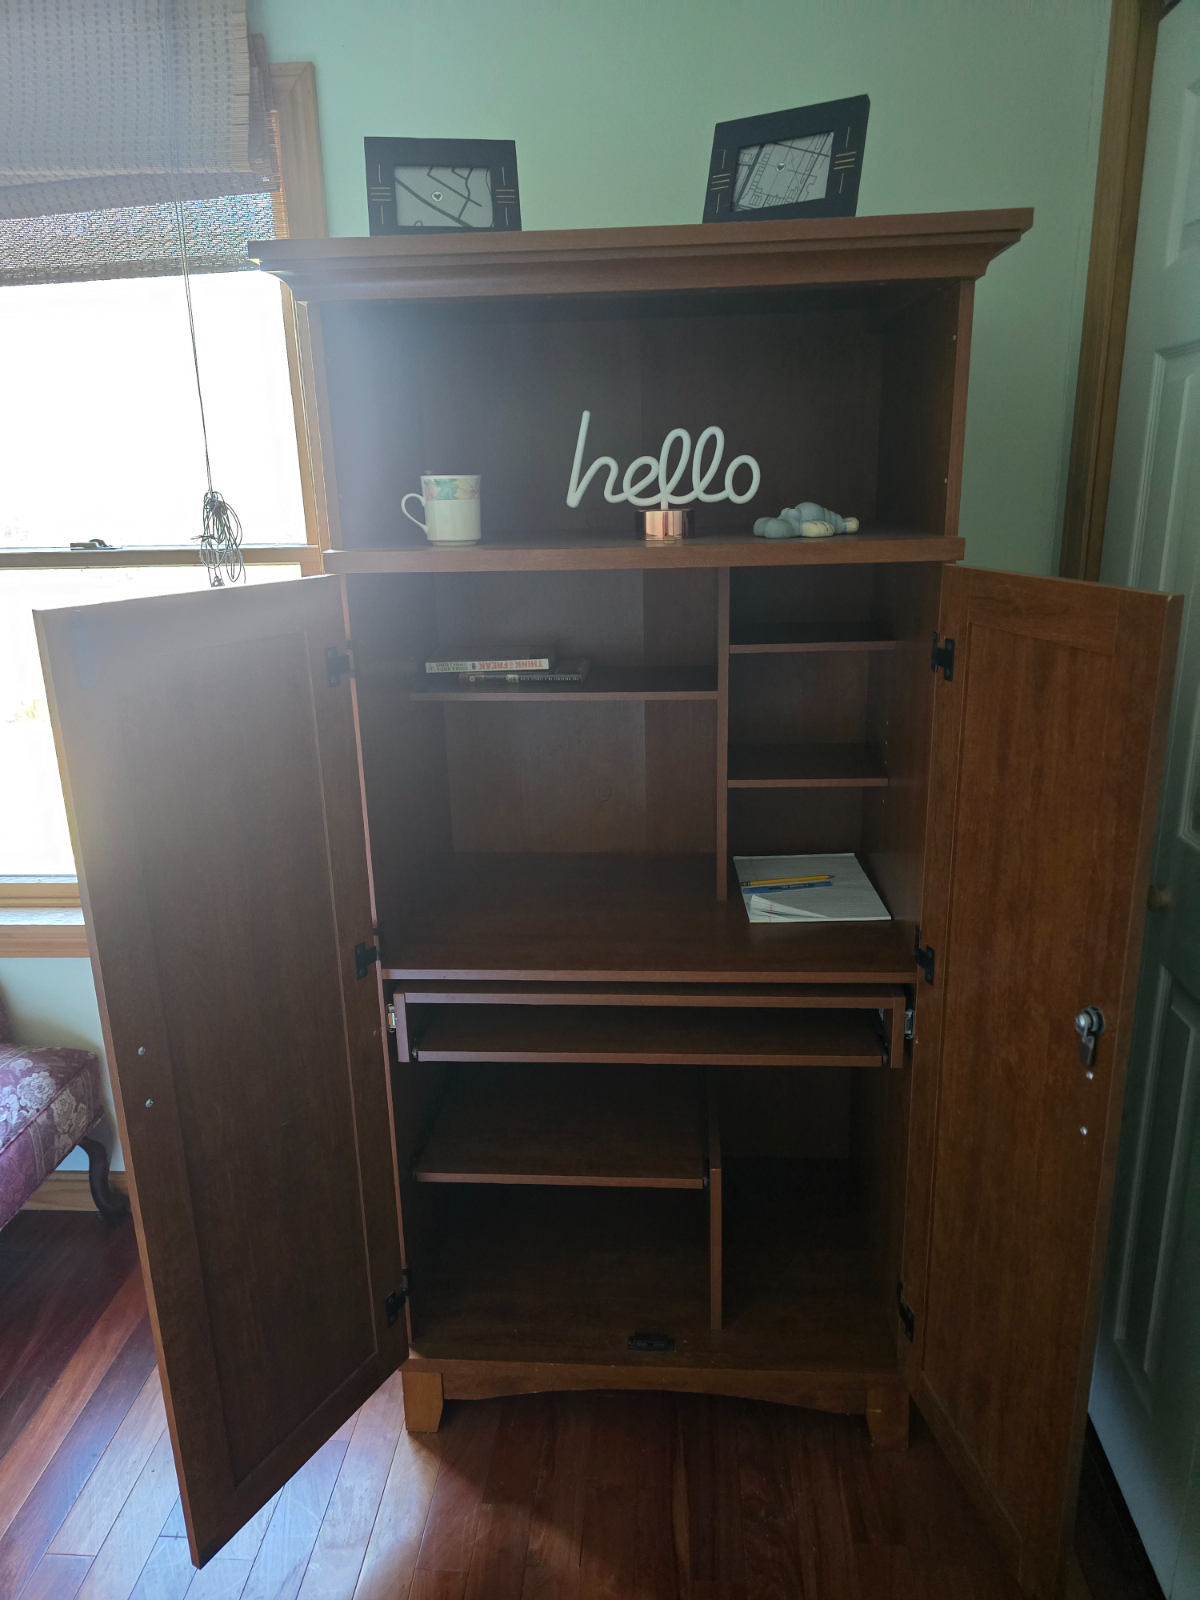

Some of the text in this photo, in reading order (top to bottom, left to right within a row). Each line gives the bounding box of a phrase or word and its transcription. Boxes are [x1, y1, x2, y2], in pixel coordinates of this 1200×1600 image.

[566, 410, 761, 508] hello
[478, 661, 508, 670] FREAK
[514, 660, 543, 669] THINK
